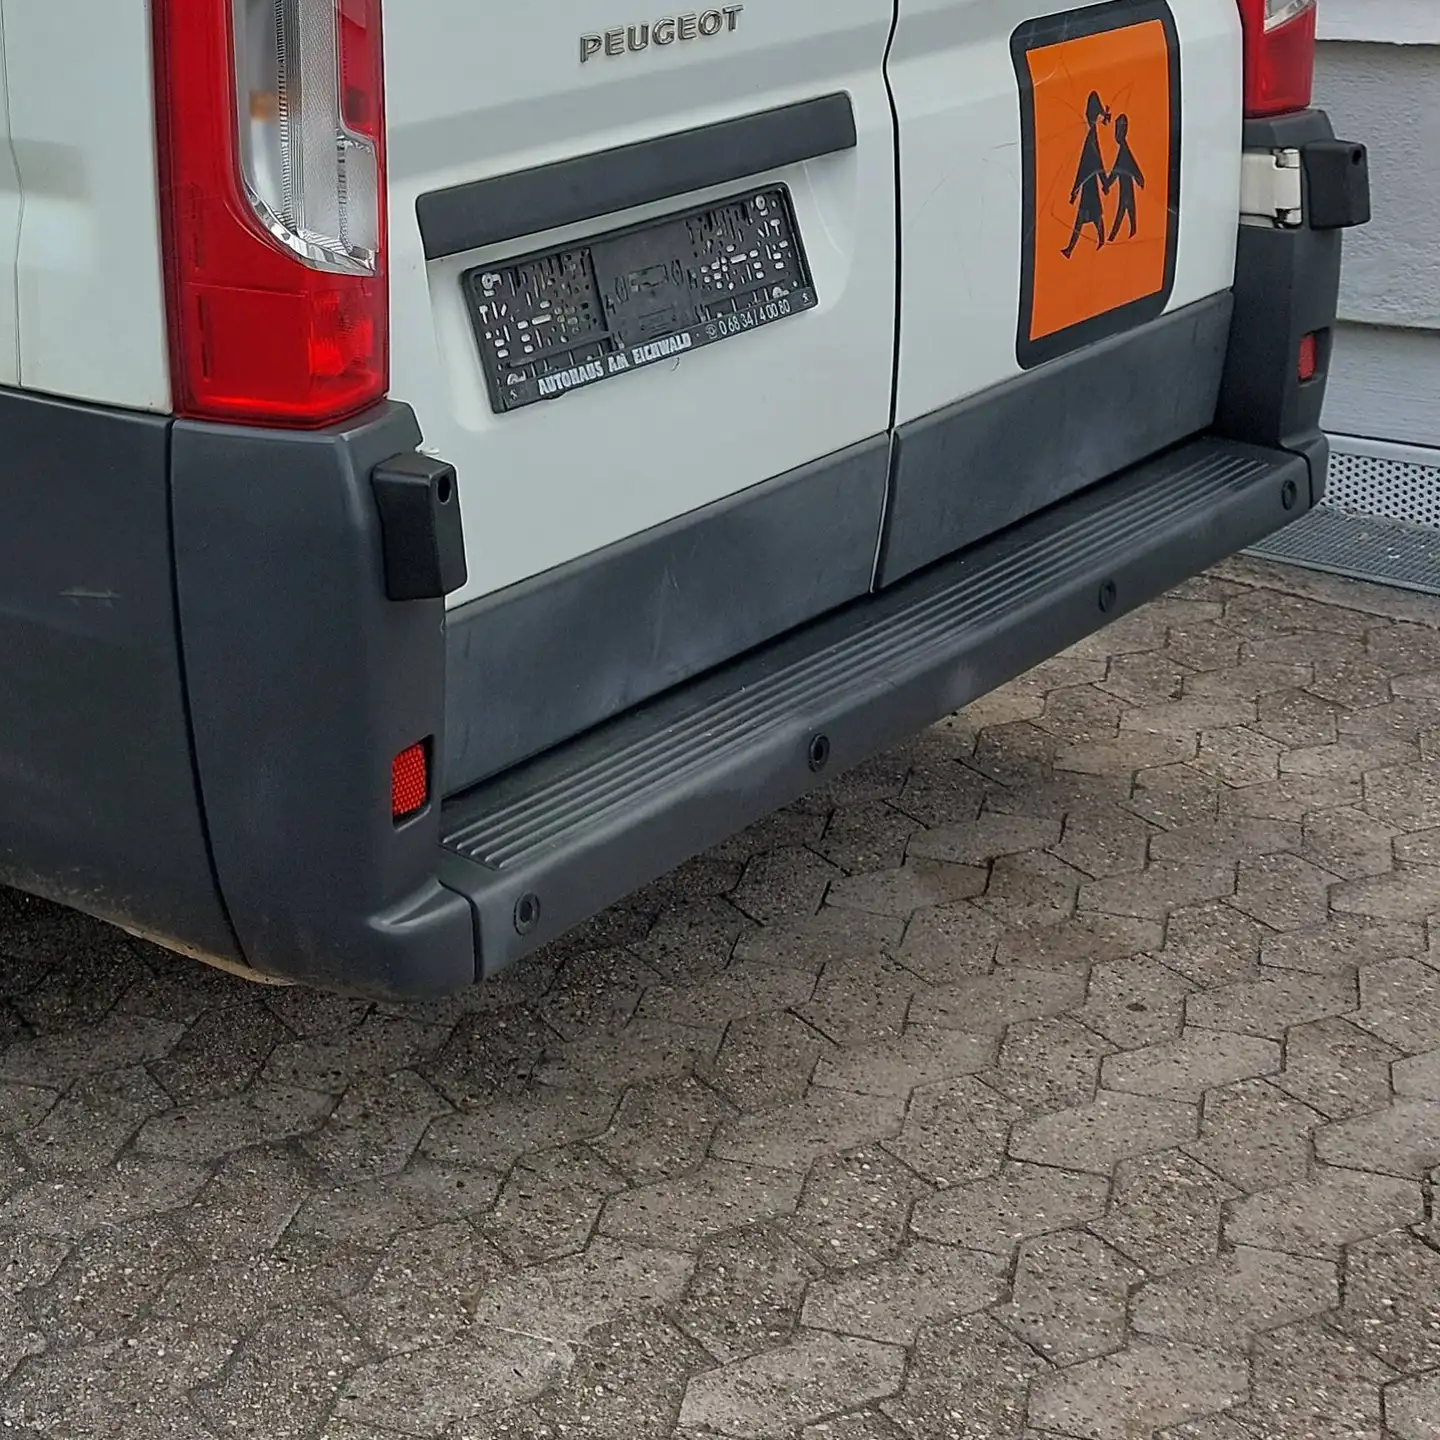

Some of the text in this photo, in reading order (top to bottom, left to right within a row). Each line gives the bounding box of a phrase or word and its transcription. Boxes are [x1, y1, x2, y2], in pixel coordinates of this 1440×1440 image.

[579, 4, 744, 63] PEUGEOT
[537, 361, 604, 396] AUTOHAUS
[607, 353, 630, 373] AM
[631, 333, 692, 364] EICHWALD
